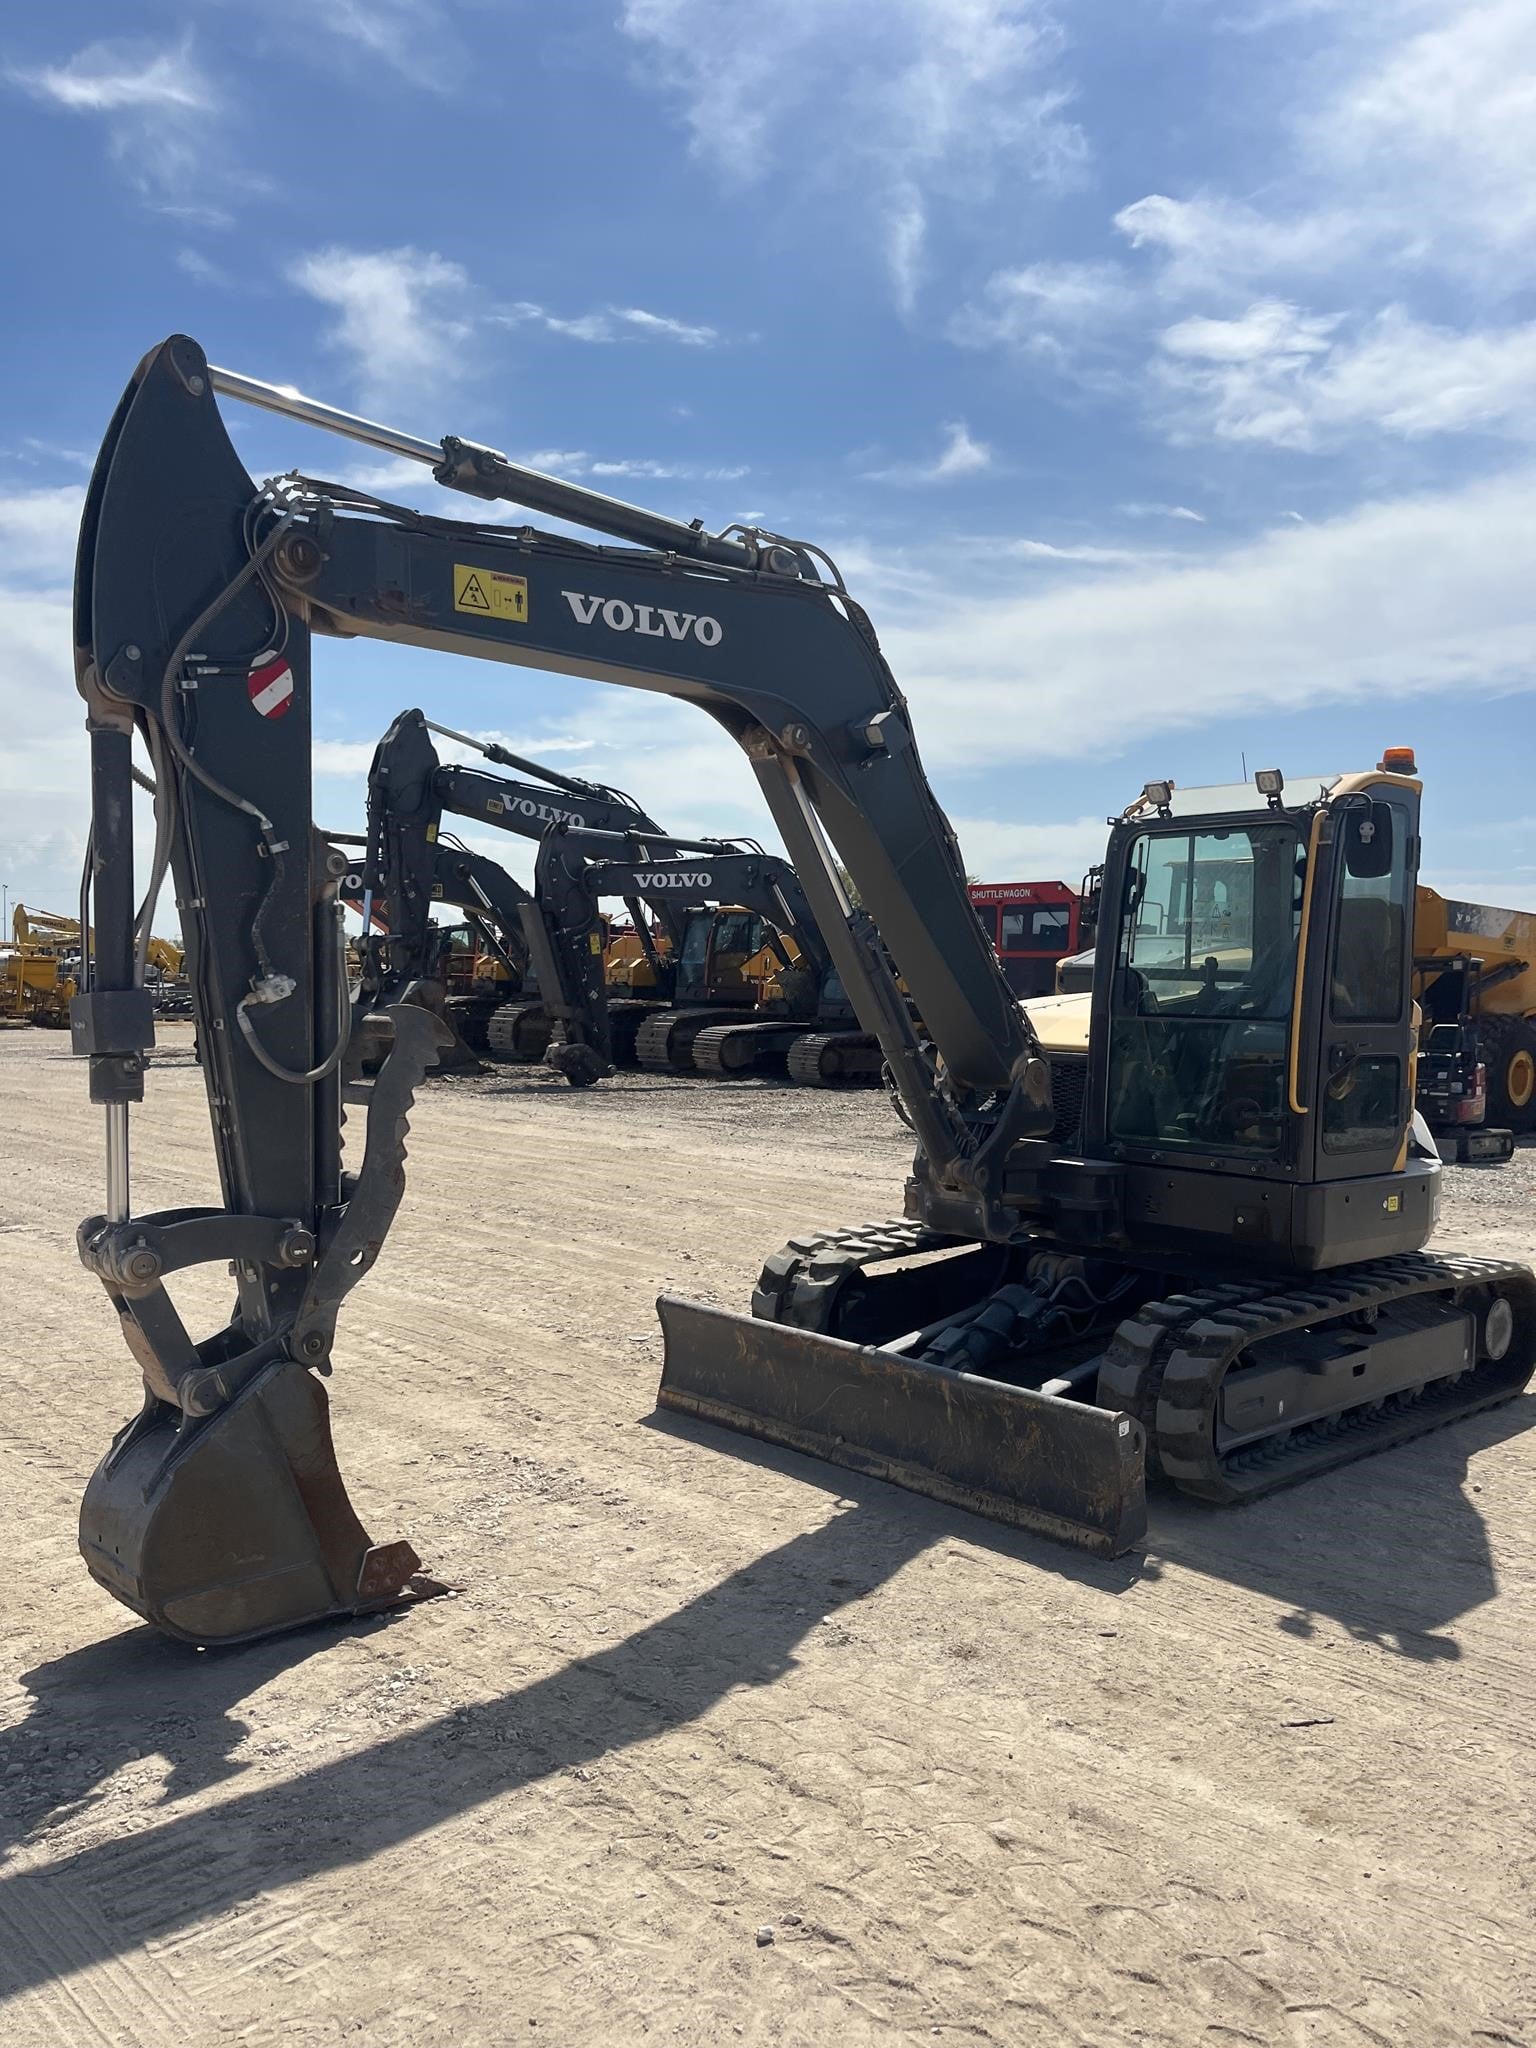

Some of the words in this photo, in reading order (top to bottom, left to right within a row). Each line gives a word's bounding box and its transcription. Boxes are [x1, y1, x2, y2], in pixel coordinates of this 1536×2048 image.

[561, 591, 723, 647] VOLVO
[500, 793, 585, 828] VOLVO
[632, 873, 713, 888] VOLVO
[971, 889, 1031, 899] SHUTTLEWAGON
